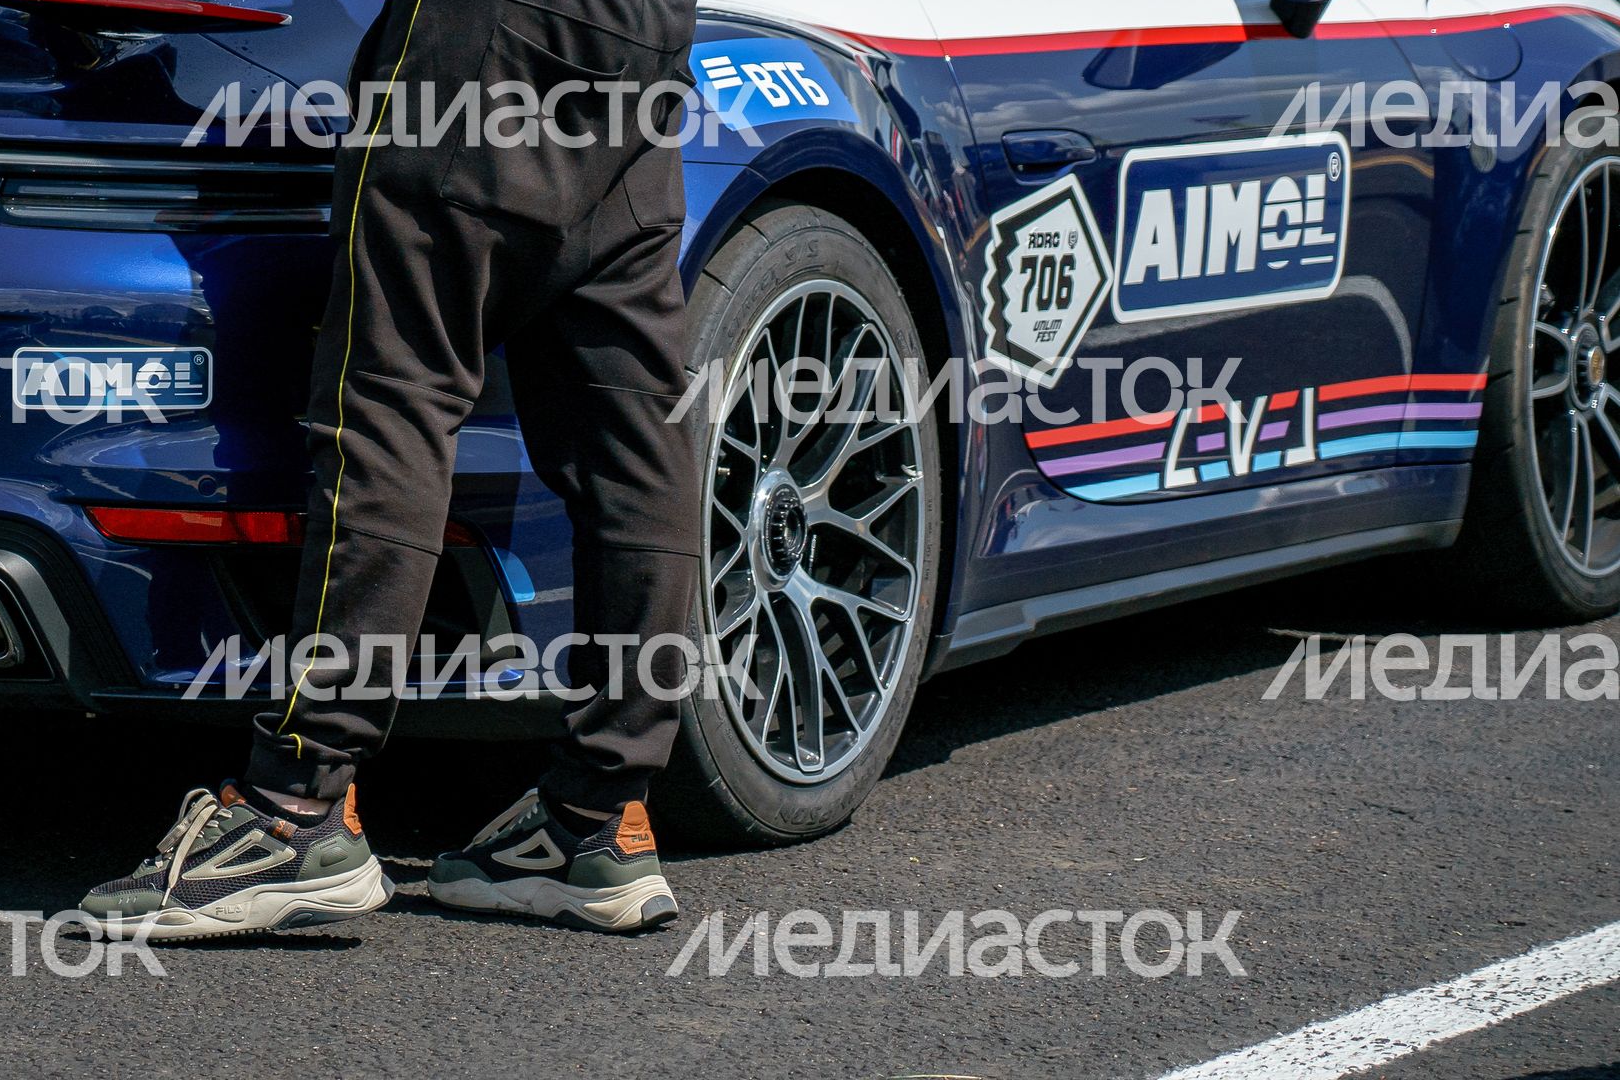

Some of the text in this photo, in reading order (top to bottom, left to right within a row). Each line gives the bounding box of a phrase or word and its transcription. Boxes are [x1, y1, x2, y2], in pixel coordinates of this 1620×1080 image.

[740, 61, 830, 107] ВТБ
[1028, 231, 1060, 249] RDRC
[1123, 175, 1337, 287] AIMOL
[1020, 253, 1076, 313] 706
[1035, 331, 1058, 342] FEST
[21, 362, 203, 396] AIMOL
[631, 832, 649, 842] FILA
[215, 904, 243, 915] FILA
